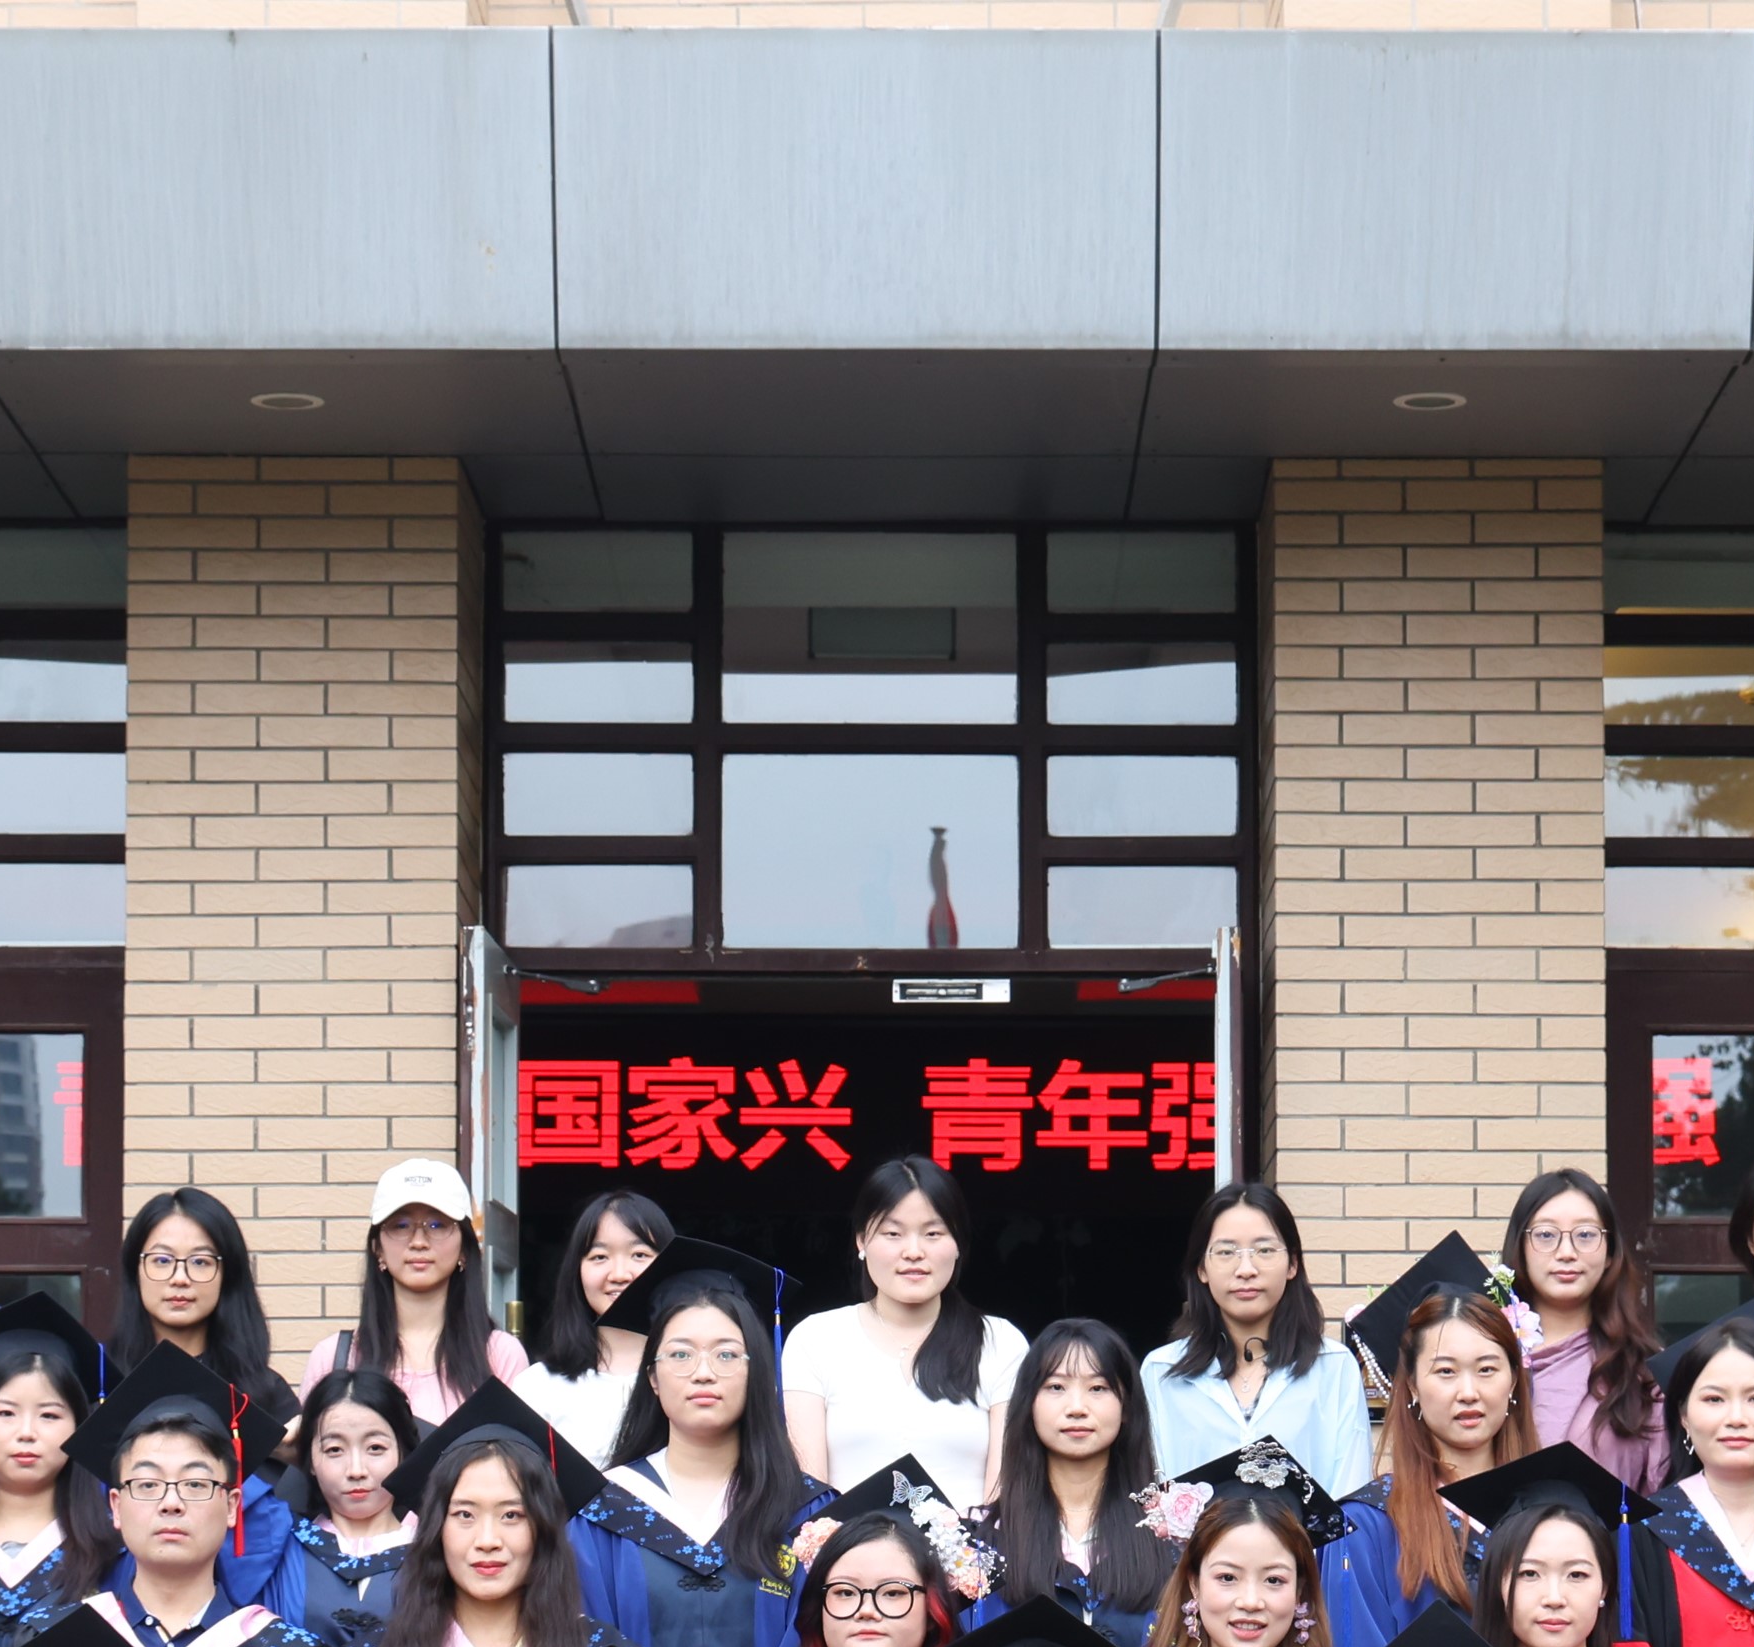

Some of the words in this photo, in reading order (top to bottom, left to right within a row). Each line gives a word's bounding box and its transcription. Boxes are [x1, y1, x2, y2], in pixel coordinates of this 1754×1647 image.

[518, 1056, 853, 1171] 国家兴
[921, 1058, 1216, 1172] 青年强
